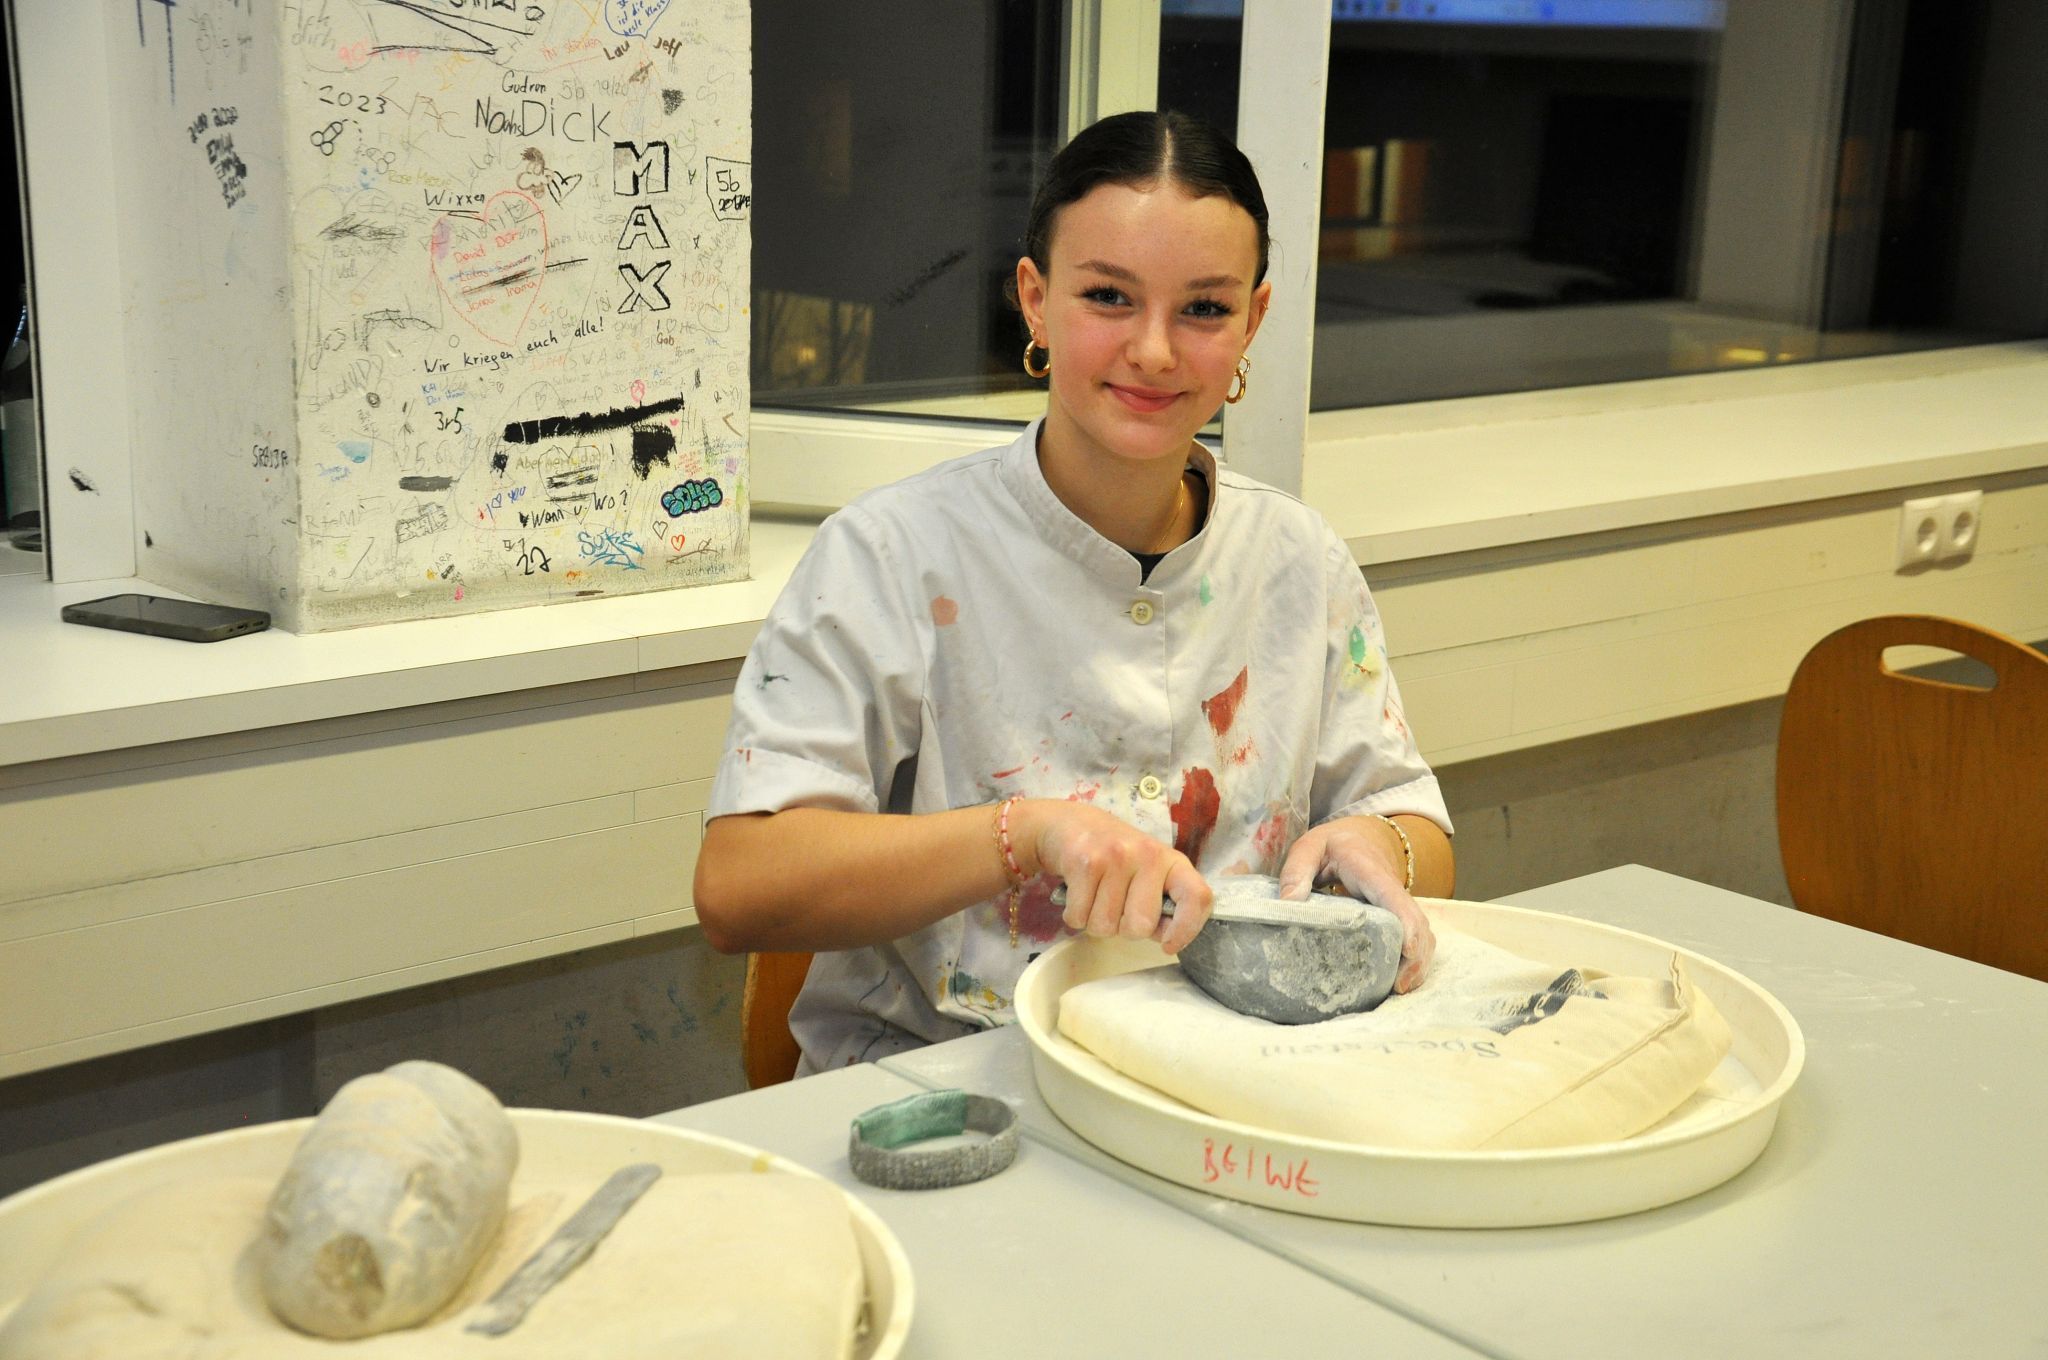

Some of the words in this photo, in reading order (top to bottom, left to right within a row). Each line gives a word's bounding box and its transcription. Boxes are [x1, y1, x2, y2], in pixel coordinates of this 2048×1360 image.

[318, 84, 388, 115] 2023
[715, 168, 740, 192] 5b
[424, 358, 449, 373] Wir
[463, 351, 514, 371] kriegen
[526, 329, 559, 352] euch
[574, 316, 605, 338] alle!
